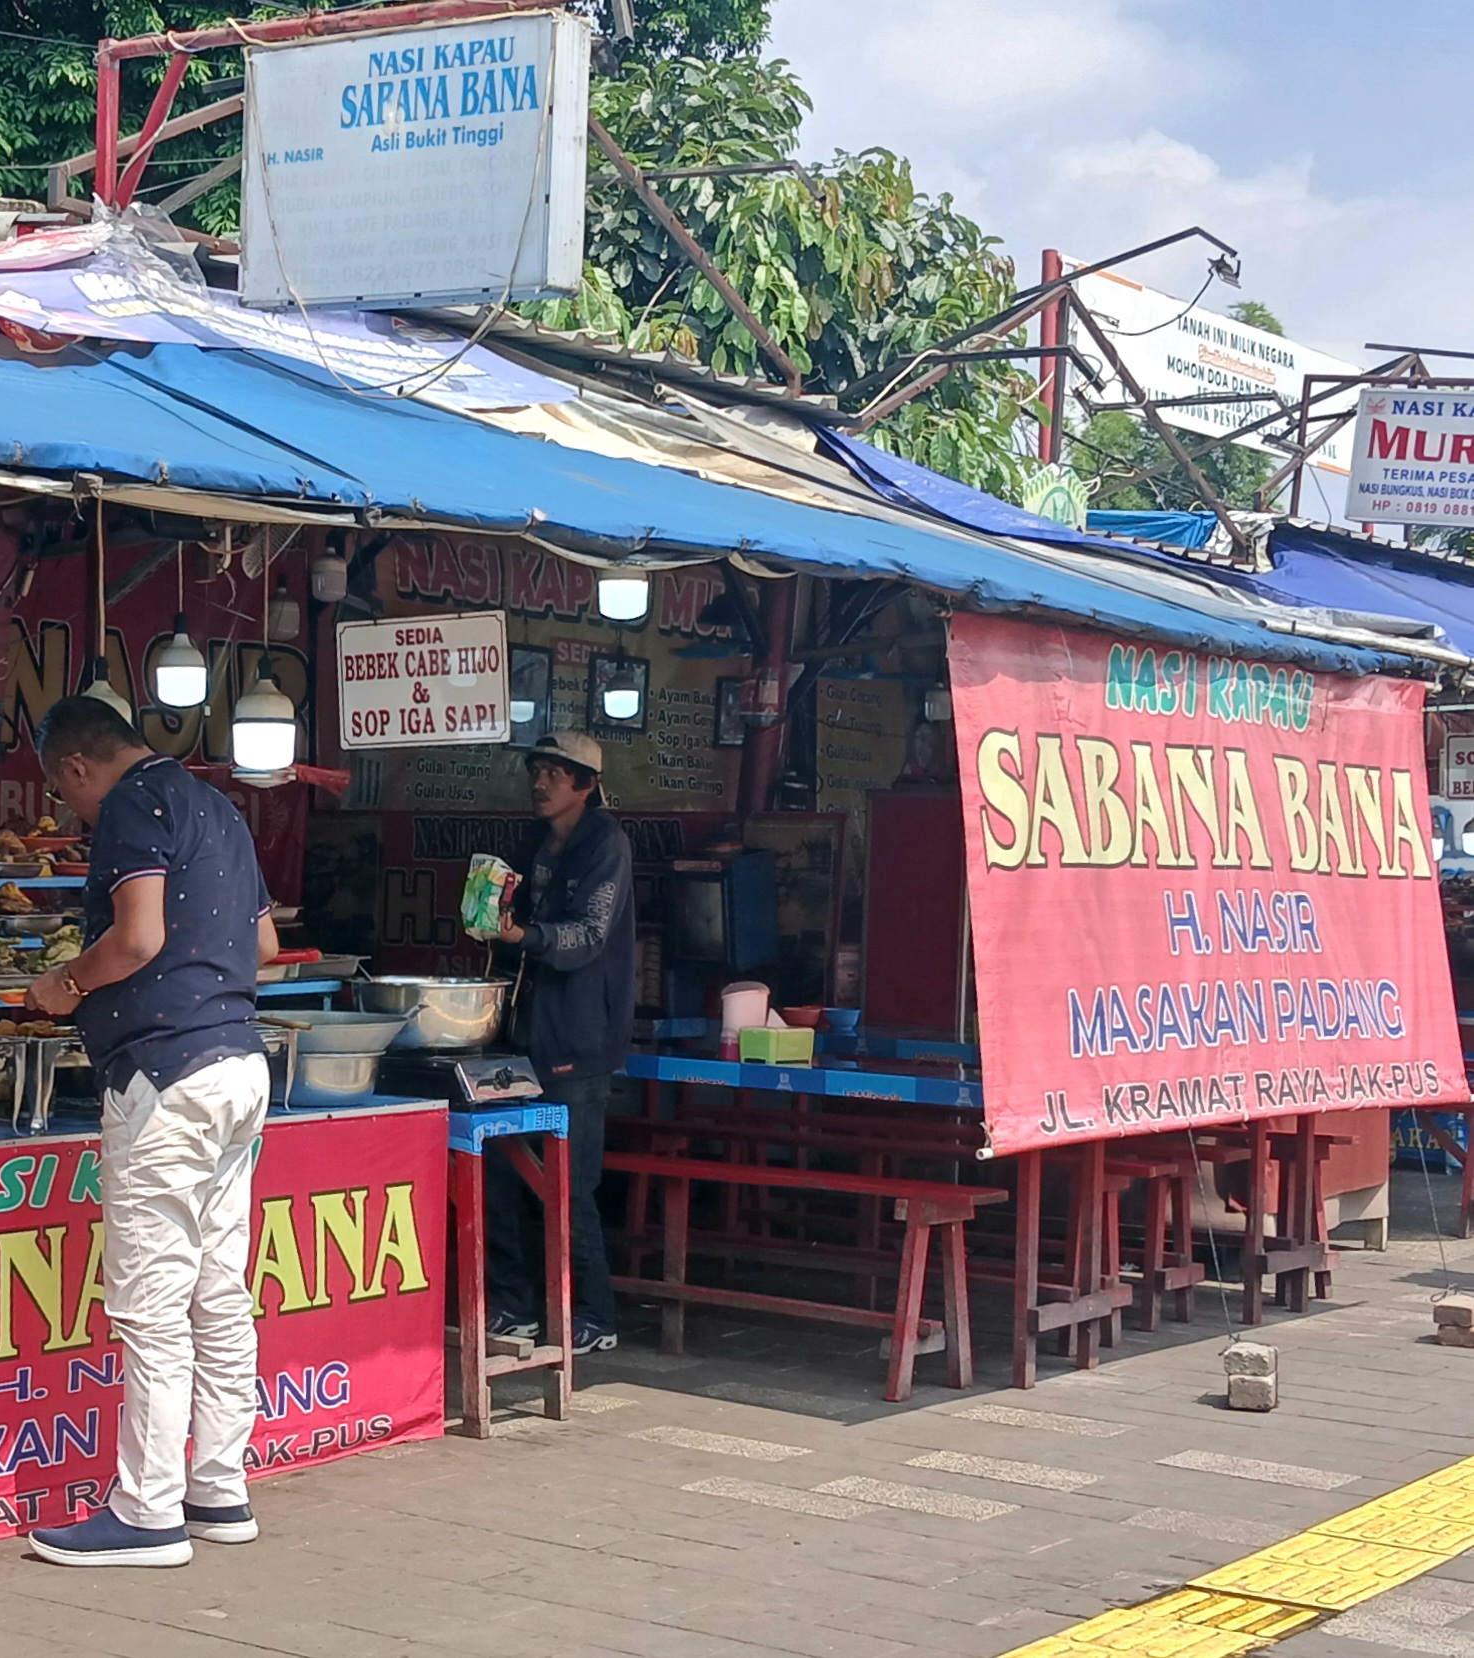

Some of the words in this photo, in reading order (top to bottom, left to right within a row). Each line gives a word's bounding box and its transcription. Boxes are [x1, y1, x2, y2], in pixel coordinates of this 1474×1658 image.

[368, 47, 423, 77] NASI
[434, 36, 516, 69] KAPAU
[460, 64, 539, 117] BANA
[371, 131, 400, 153] Asli
[405, 128, 447, 148] Bukit
[452, 121, 504, 147] Tinggi
[267, 151, 281, 166] H.
[284, 147, 324, 164] NASIR
[1177, 315, 1210, 340] TANAH
[1213, 327, 1227, 346] INI
[1230, 333, 1256, 355] MILIK
[1259, 343, 1295, 370] NEGARA
[1167, 355, 1205, 381] MOHON
[1208, 368, 1228, 388] DOA
[1232, 376, 1252, 394] DAN
[1392, 400, 1444, 416] NASI
[1359, 483, 1379, 494] NASI
[1380, 484, 1425, 498] BUNGKUS,
[1427, 486, 1448, 498] NASI
[1450, 488, 1469, 499] BOX
[1383, 468, 1435, 482] TERIMA
[1372, 500, 1391, 511] HP
[1406, 501, 1437, 514] 0819
[395, 535, 502, 607] NASI
[395, 627, 444, 648] SEDIA
[344, 652, 401, 683] BEBEK
[404, 647, 452, 677] CABE
[457, 644, 500, 675] HIJO
[413, 681, 431, 704] &
[658, 688, 690, 705] Ayam
[1105, 643, 1198, 719] NASI
[1206, 653, 1315, 732] KAPAU
[351, 708, 391, 738] SOP
[398, 705, 438, 735] IGA
[445, 703, 497, 732] SAPI
[658, 710, 690, 727] Ayam
[657, 731, 680, 748] Sop
[657, 753, 684, 768] Ikan
[659, 775, 685, 790] Ikan
[976, 725, 1273, 874] SABANA
[1272, 753, 1432, 879] BANA
[1164, 889, 1213, 956] H.
[1218, 889, 1322, 955] NASIR
[1068, 980, 1268, 1059] MASAKAN
[1273, 979, 1406, 1043] PADANG
[1039, 1091, 1094, 1135] JL.
[1102, 1072, 1246, 1128] KRAMAT
[1252, 1066, 1330, 1109] RAYA
[1332, 1060, 1441, 1103] JAK-PUS
